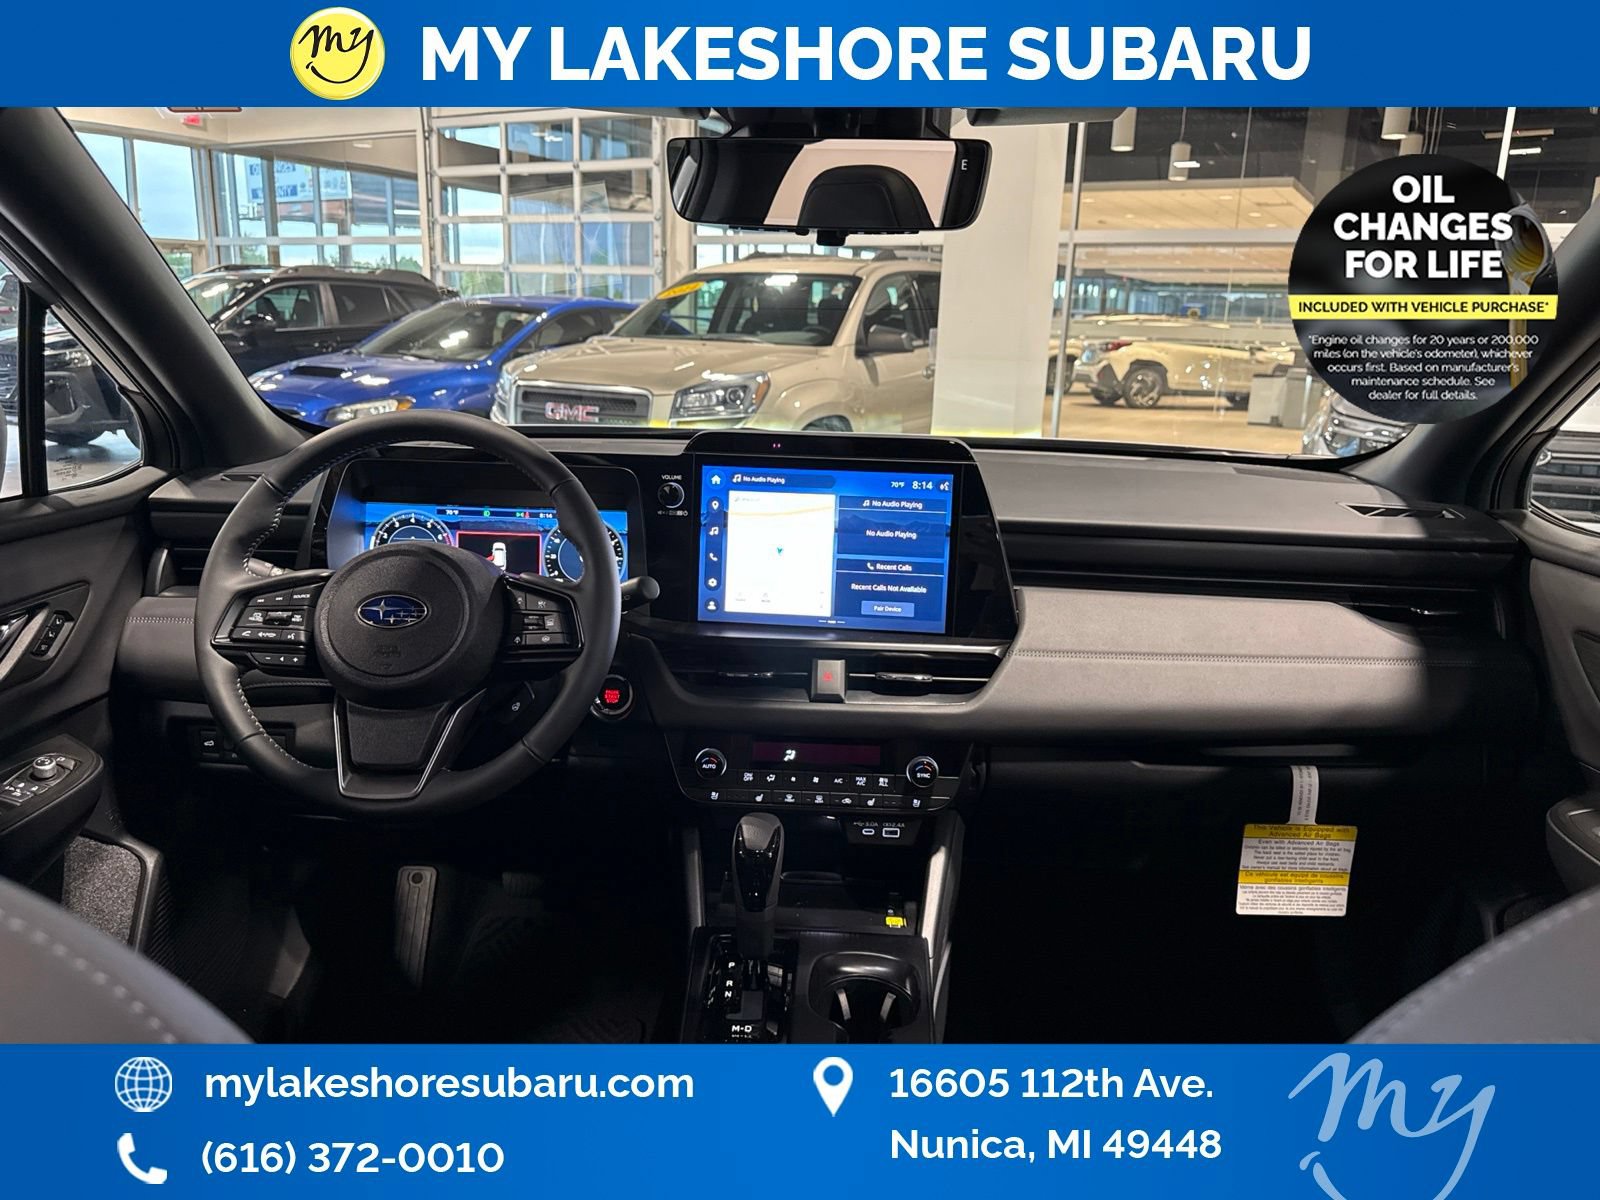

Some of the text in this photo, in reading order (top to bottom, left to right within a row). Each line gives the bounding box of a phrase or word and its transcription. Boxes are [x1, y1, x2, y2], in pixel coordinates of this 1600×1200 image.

[961, 160, 968, 170] E
[544, 402, 600, 422] GMC
[912, 481, 933, 490] 8:14
[901, 501, 923, 509] Playing
[895, 531, 917, 540] Playing
